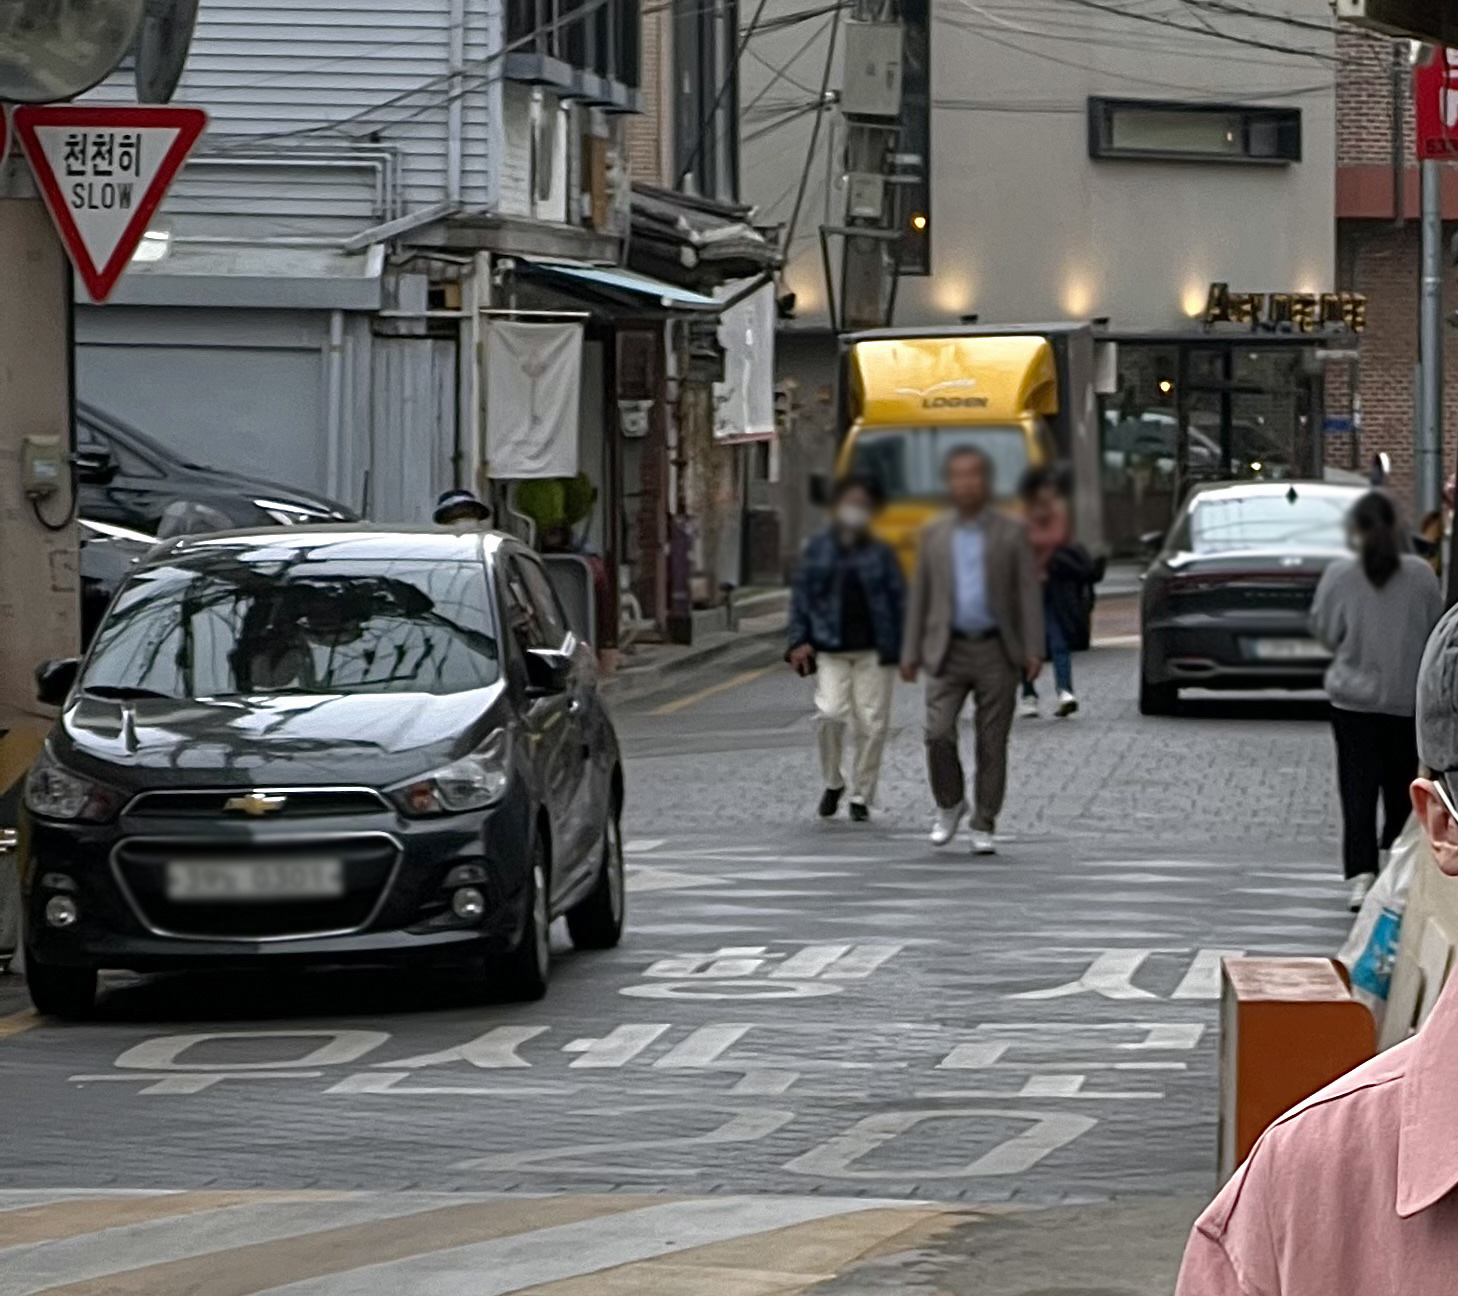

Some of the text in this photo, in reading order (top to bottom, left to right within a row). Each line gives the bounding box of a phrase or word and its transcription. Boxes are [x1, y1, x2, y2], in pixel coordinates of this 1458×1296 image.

[64, 133, 141, 177] 천천히
[71, 182, 133, 209] SLOW
[452, 1103, 1098, 1178] 20
